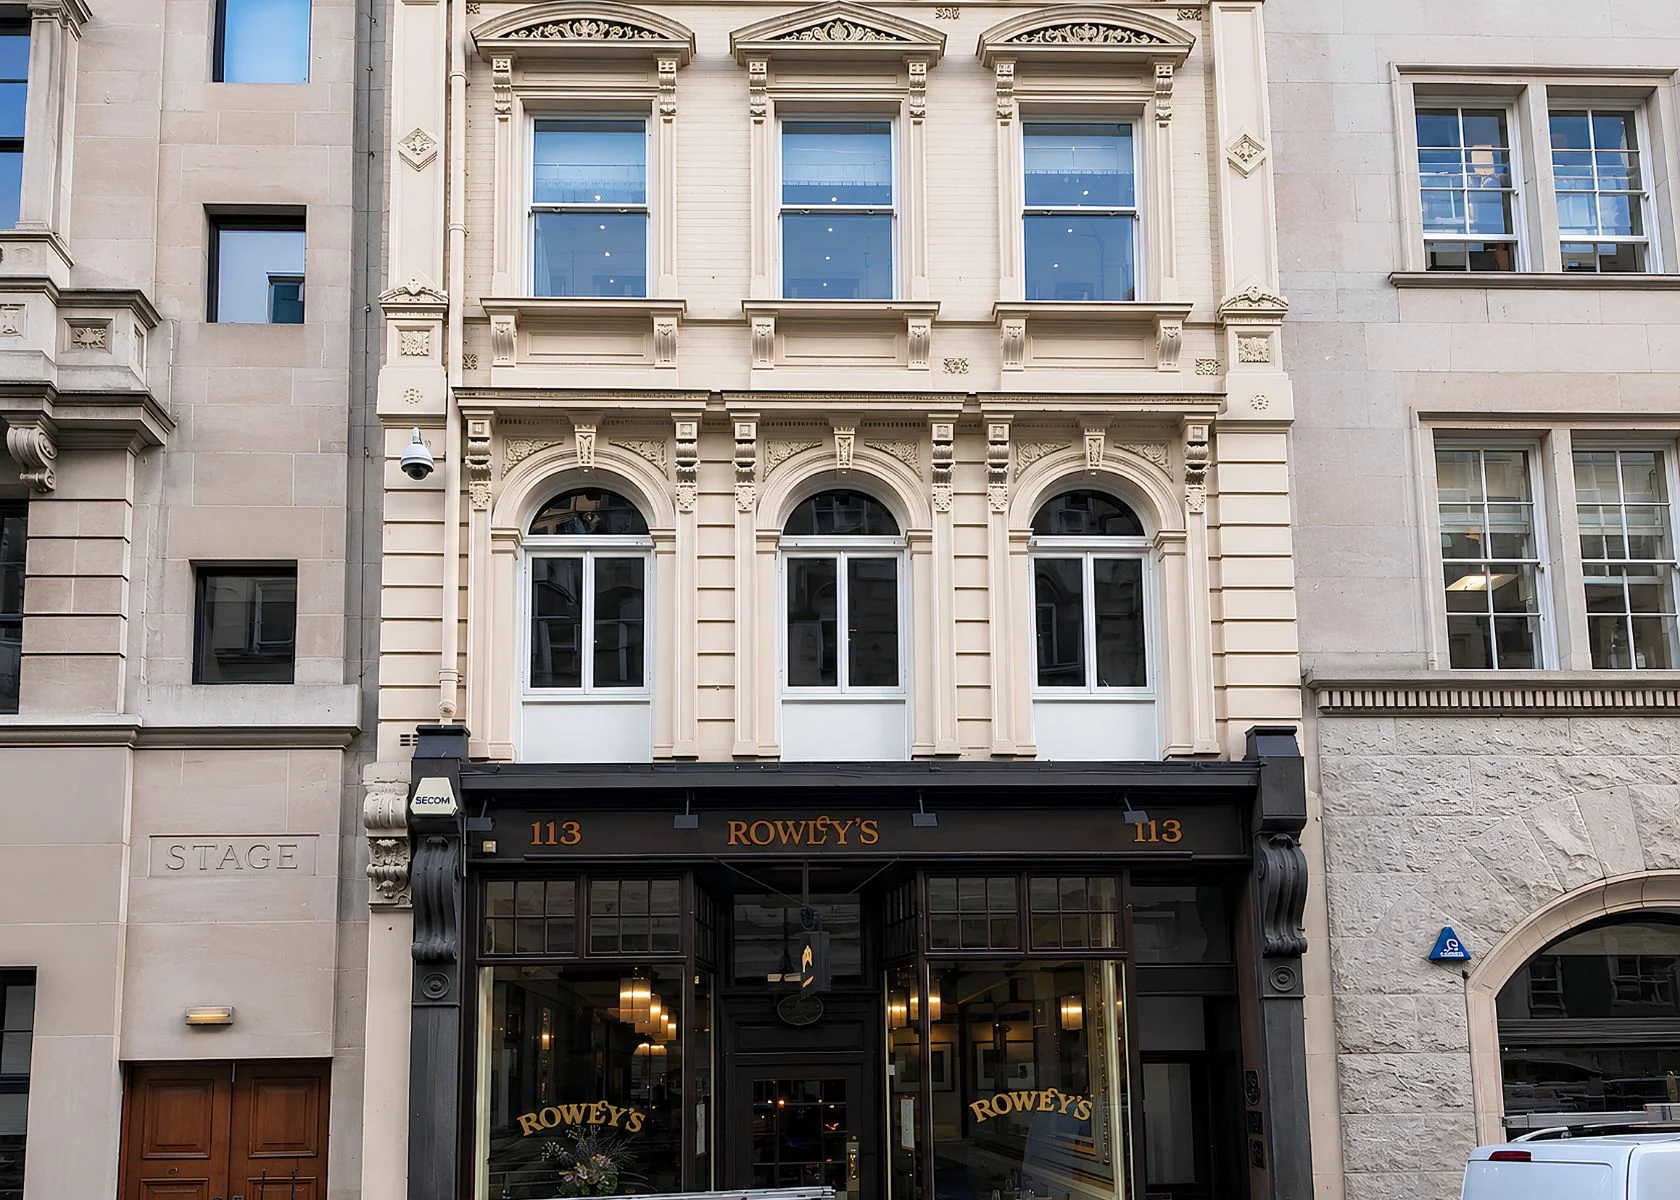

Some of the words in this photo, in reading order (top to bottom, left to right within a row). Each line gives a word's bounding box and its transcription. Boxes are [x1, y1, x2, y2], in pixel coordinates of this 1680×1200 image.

[415, 796, 450, 805] SECOM
[530, 821, 582, 845] 113
[1134, 819, 1182, 843] 113
[165, 844, 298, 871] STAGE
